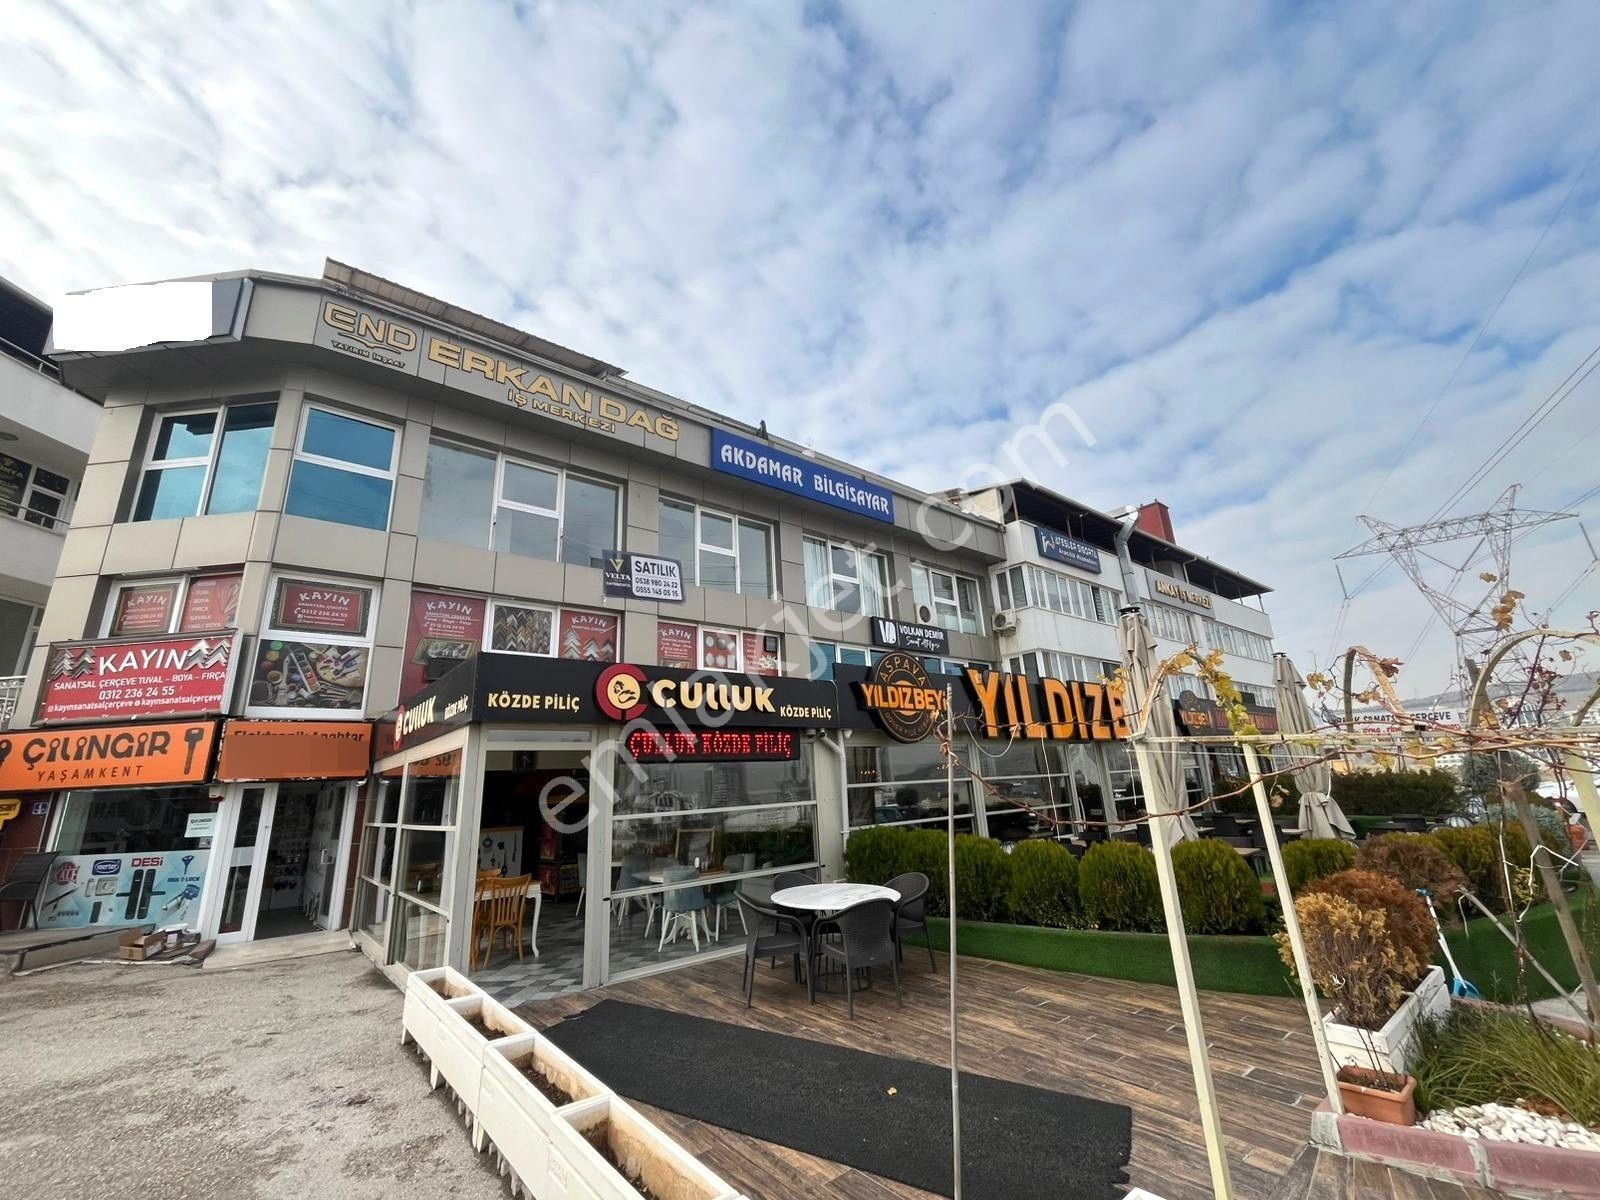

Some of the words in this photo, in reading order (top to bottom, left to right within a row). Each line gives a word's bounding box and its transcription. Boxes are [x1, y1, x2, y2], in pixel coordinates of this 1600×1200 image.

[323, 302, 417, 351] END
[331, 340, 370, 358] YATIRIM
[532, 398, 616, 433] MERKEZİ
[721, 444, 803, 487] AKDAMAR
[813, 474, 889, 515] BİLGİSAYAR
[605, 572, 631, 580] VELTA
[634, 560, 676, 578] SATILIK
[635, 577, 650, 585] 0538
[127, 595, 167, 607] KAYIN
[299, 591, 350, 605] KAYIN
[426, 601, 472, 615] KAYIN
[571, 615, 607, 627] KAYIN
[661, 629, 691, 639] KAYIN
[899, 624, 923, 637] VOLKAN
[99, 649, 188, 676] KAYIN
[880, 656, 926, 687] ASPAVA
[54, 680, 97, 691] SANATSAL
[99, 677, 137, 688] ÇERÇEVE
[138, 676, 163, 684] TUVAL
[172, 674, 193, 682] BOYA
[202, 672, 226, 681] FIRÇA
[99, 689, 121, 700] 0312
[124, 688, 142, 699] 236
[146, 687, 158, 697] 24
[162, 686, 175, 696] 55
[487, 692, 541, 709] KÖZDE
[544, 693, 580, 713] PİLİÇ
[780, 705, 809, 718] KÖZDE
[810, 706, 832, 720] PİLİÇ
[22, 731, 170, 771] ÇİLİNGİR
[630, 733, 697, 759] ÇULLUK
[702, 731, 751, 753] KÖZDE
[755, 731, 792, 758] PİLİÇ
[37, 765, 143, 782] YAŞAMKENT
